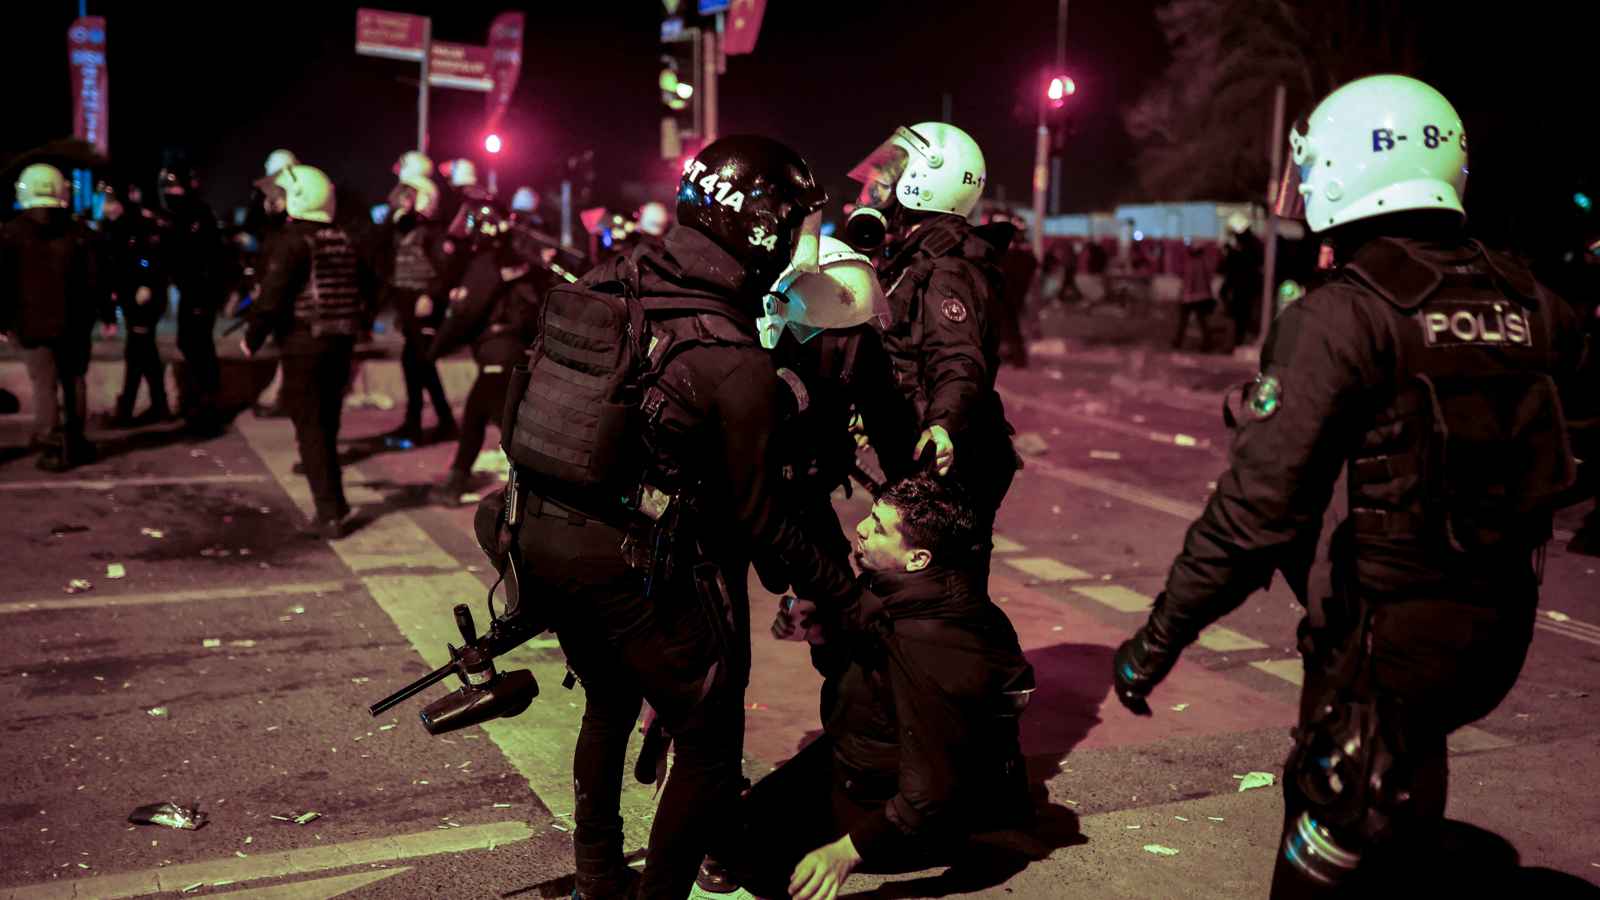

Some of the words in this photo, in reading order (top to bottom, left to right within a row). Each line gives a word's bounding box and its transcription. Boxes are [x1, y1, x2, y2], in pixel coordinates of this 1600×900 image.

[904, 185, 919, 196] 34
[748, 226, 778, 251] 34
[1425, 304, 1525, 343] POLİS
